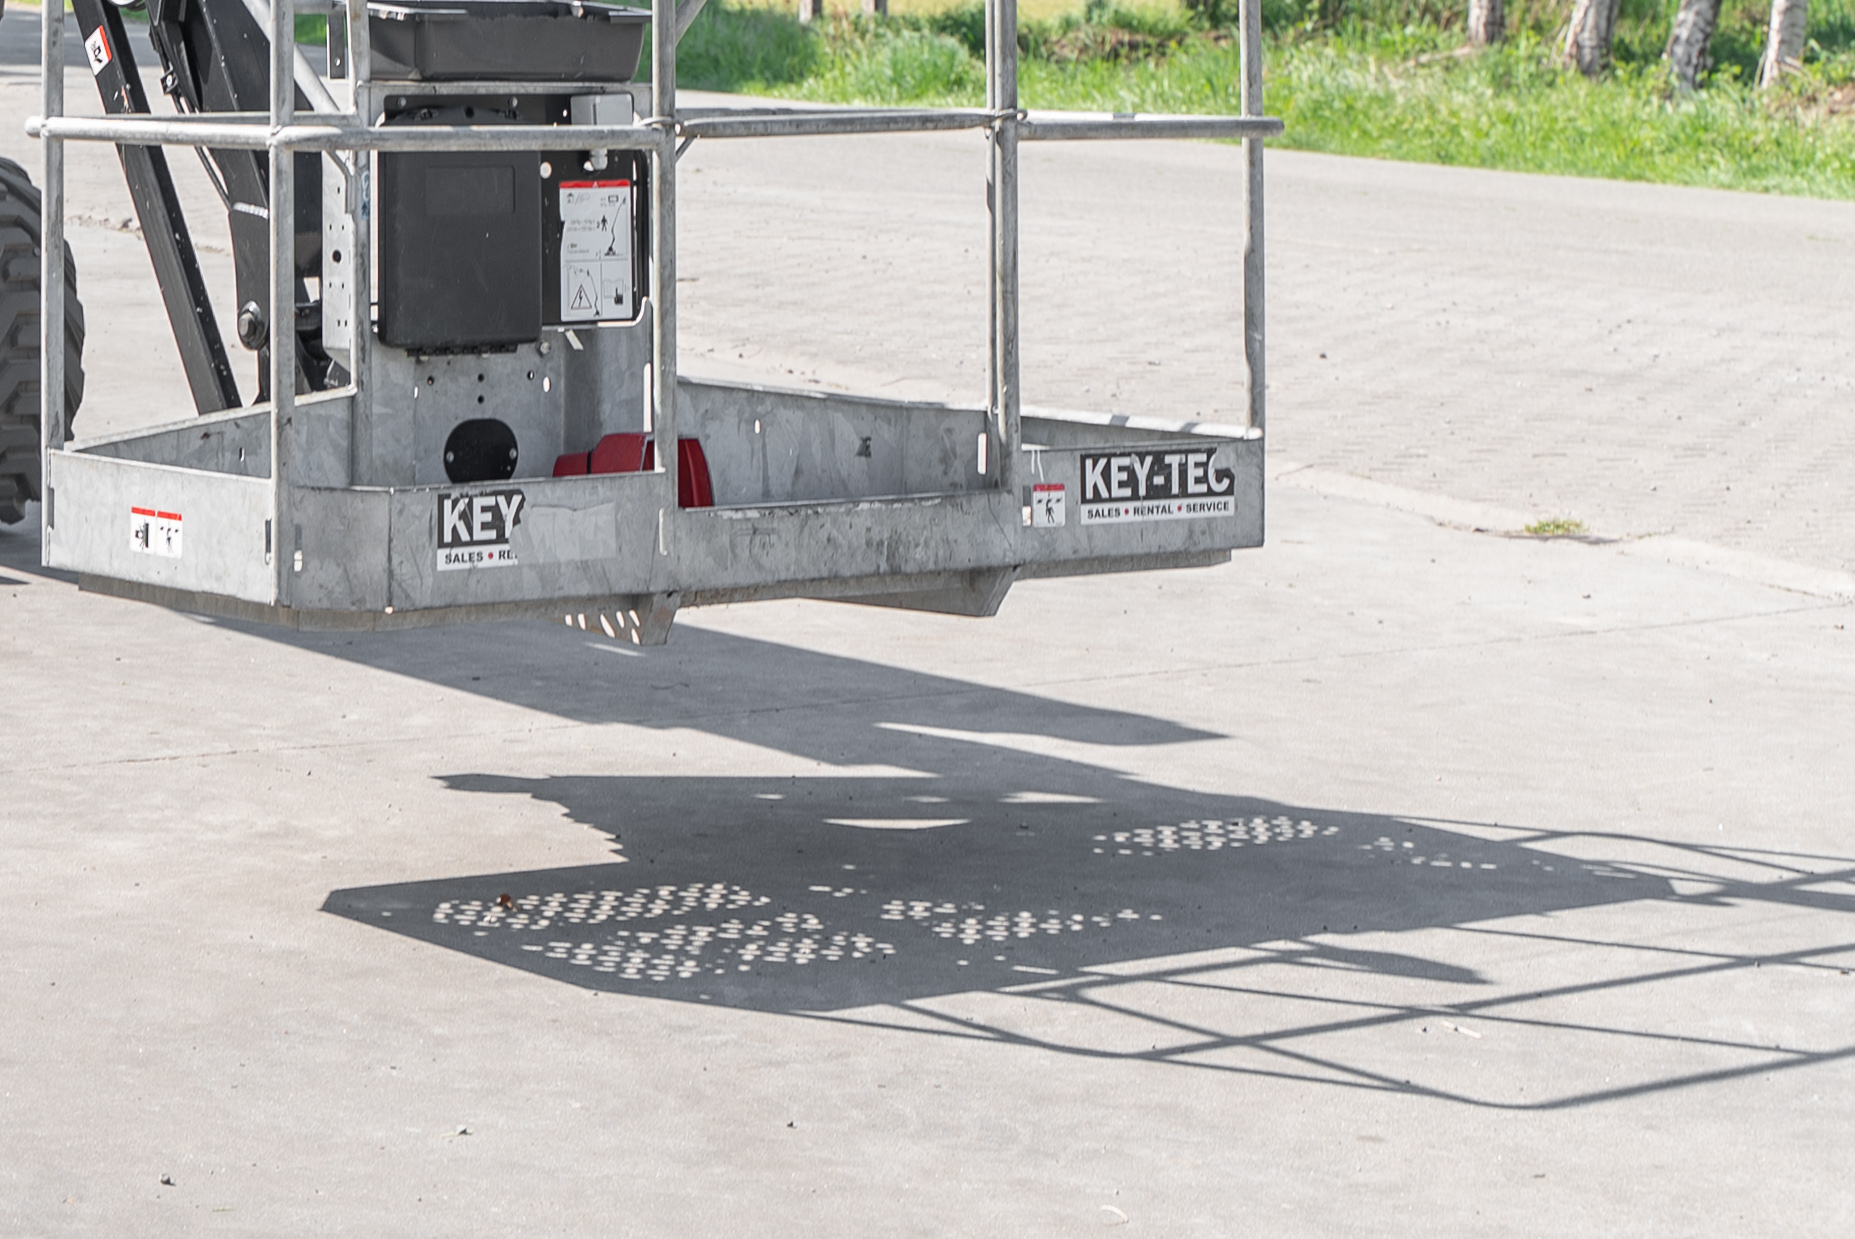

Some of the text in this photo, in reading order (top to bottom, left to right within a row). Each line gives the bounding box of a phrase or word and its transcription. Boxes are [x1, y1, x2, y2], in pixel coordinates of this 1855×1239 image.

[1085, 453, 1230, 500] KEY-TEC
[443, 494, 523, 544] KEY
[1087, 501, 1229, 519] SALES RENTAL SERVICE
[445, 551, 484, 564] SALES
